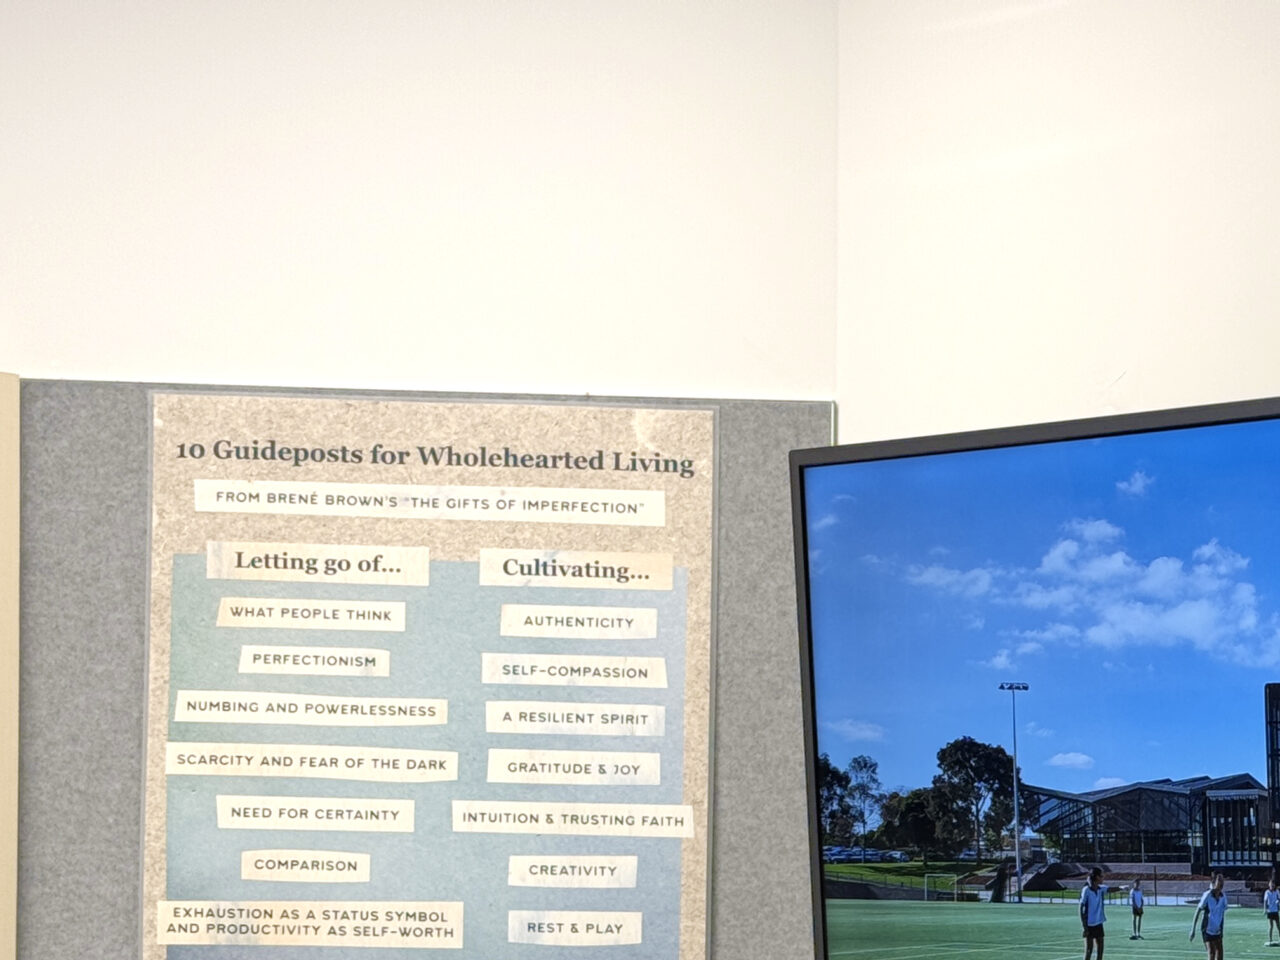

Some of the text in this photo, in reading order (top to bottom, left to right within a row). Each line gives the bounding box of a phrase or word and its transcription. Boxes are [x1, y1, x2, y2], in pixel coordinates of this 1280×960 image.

[176, 439, 695, 479] 10 Guideposts for Wholehearted Living
[216, 491, 260, 503] FROM
[266, 491, 318, 505] BRENÉ
[325, 494, 398, 508] BROWN'S
[446, 497, 490, 510] GIFTS
[495, 499, 516, 511] OF
[235, 551, 401, 576] Letting go of...
[502, 558, 650, 584] Cultivating...
[229, 606, 392, 621] WHAT PEOPLE THINK
[524, 615, 634, 629] AUTHENTICITY
[252, 653, 376, 668] PERFECTIONISM
[502, 664, 648, 679] SELF-COMPASSION
[187, 701, 437, 717] NUMBING AND POWERLESSNESS
[502, 711, 649, 725] A RESILIENT SPIRIT
[177, 753, 447, 770] SCARCITY AND FEAR OF THE DARK
[507, 762, 641, 776] GRATITUDE & JOY
[231, 807, 400, 821] NEED FOR CERTAINTY
[462, 812, 684, 827] INTUITION & TRUSTING FAITH
[254, 858, 358, 872] COMPARISON
[528, 864, 617, 877] CREATIVITY
[173, 906, 448, 923] EXHAUSTION AS A STATUS SYMBOL
[166, 923, 454, 938] AND PRODUCTIVITY AS SELF-WORTH
[527, 922, 624, 935] REST & PLAY
